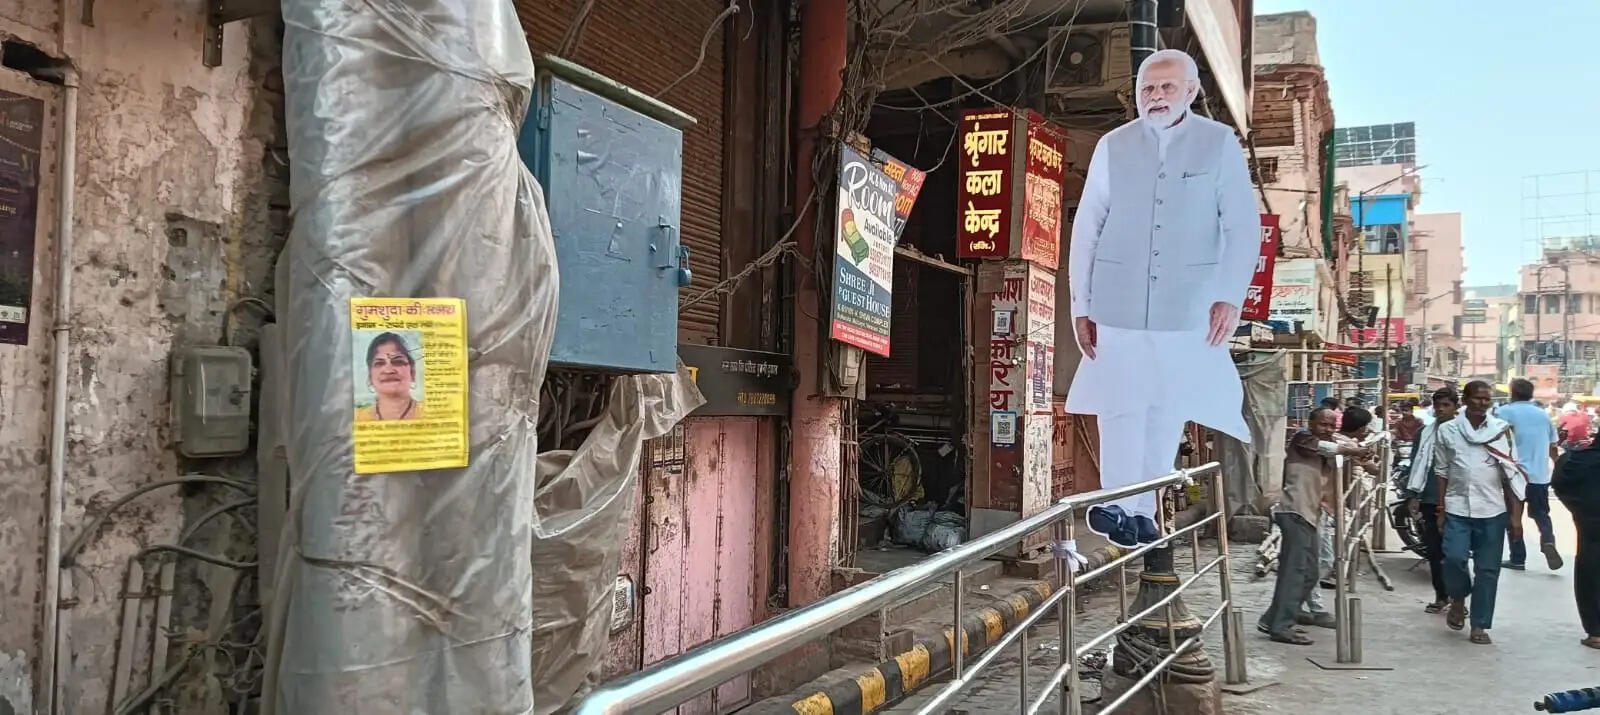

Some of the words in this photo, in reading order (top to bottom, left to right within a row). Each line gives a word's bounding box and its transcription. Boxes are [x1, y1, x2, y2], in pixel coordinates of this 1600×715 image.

[965, 170, 1003, 196] कला
[864, 217, 892, 245] Available
[964, 199, 1002, 238] केन्द्र
[355, 304, 402, 321] गुमशुदा
[406, 301, 422, 316] की
